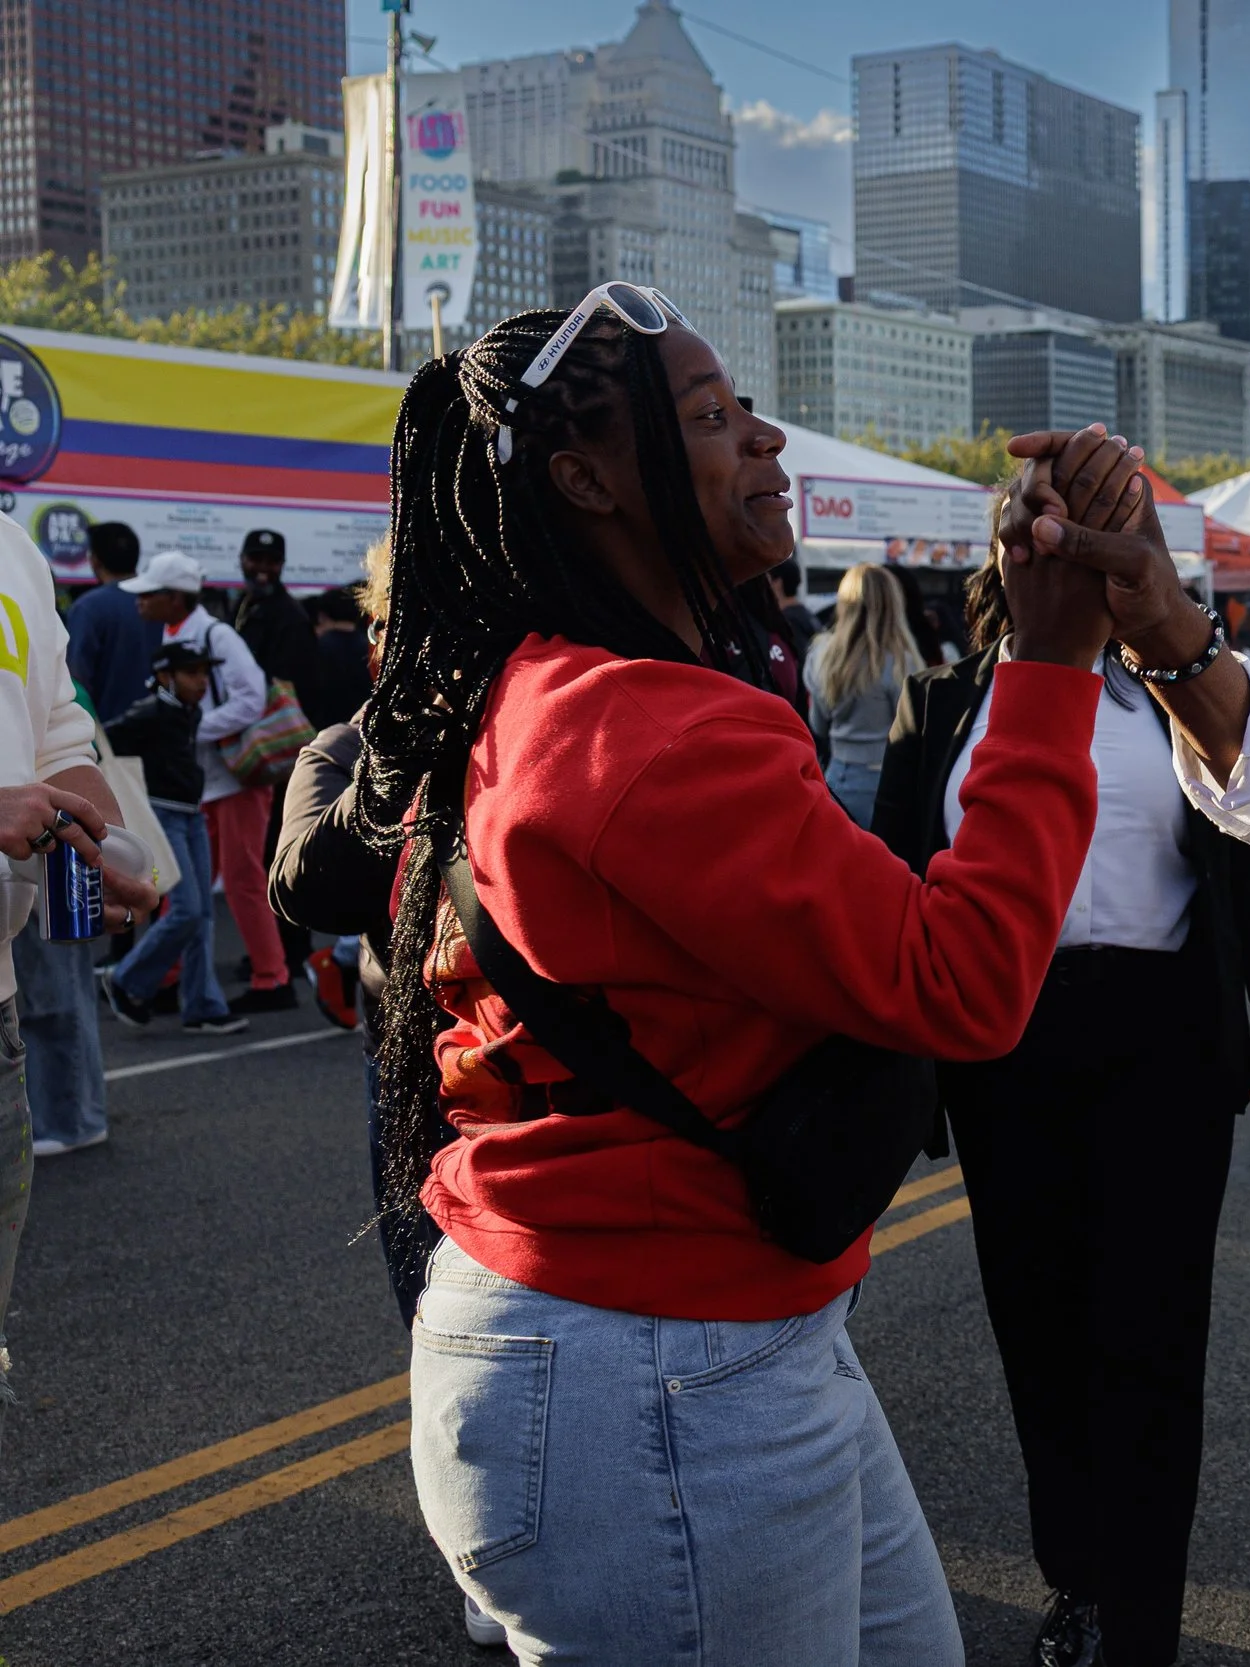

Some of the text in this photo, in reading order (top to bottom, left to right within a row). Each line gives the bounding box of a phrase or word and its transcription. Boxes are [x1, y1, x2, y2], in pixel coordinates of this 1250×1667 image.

[409, 174, 468, 192] FOOD
[419, 200, 461, 219] FUN
[407, 226, 473, 246] MUSIC
[420, 253, 461, 270] ART
[547, 311, 586, 358] HYUNDAI
[812, 497, 853, 519] DAO
